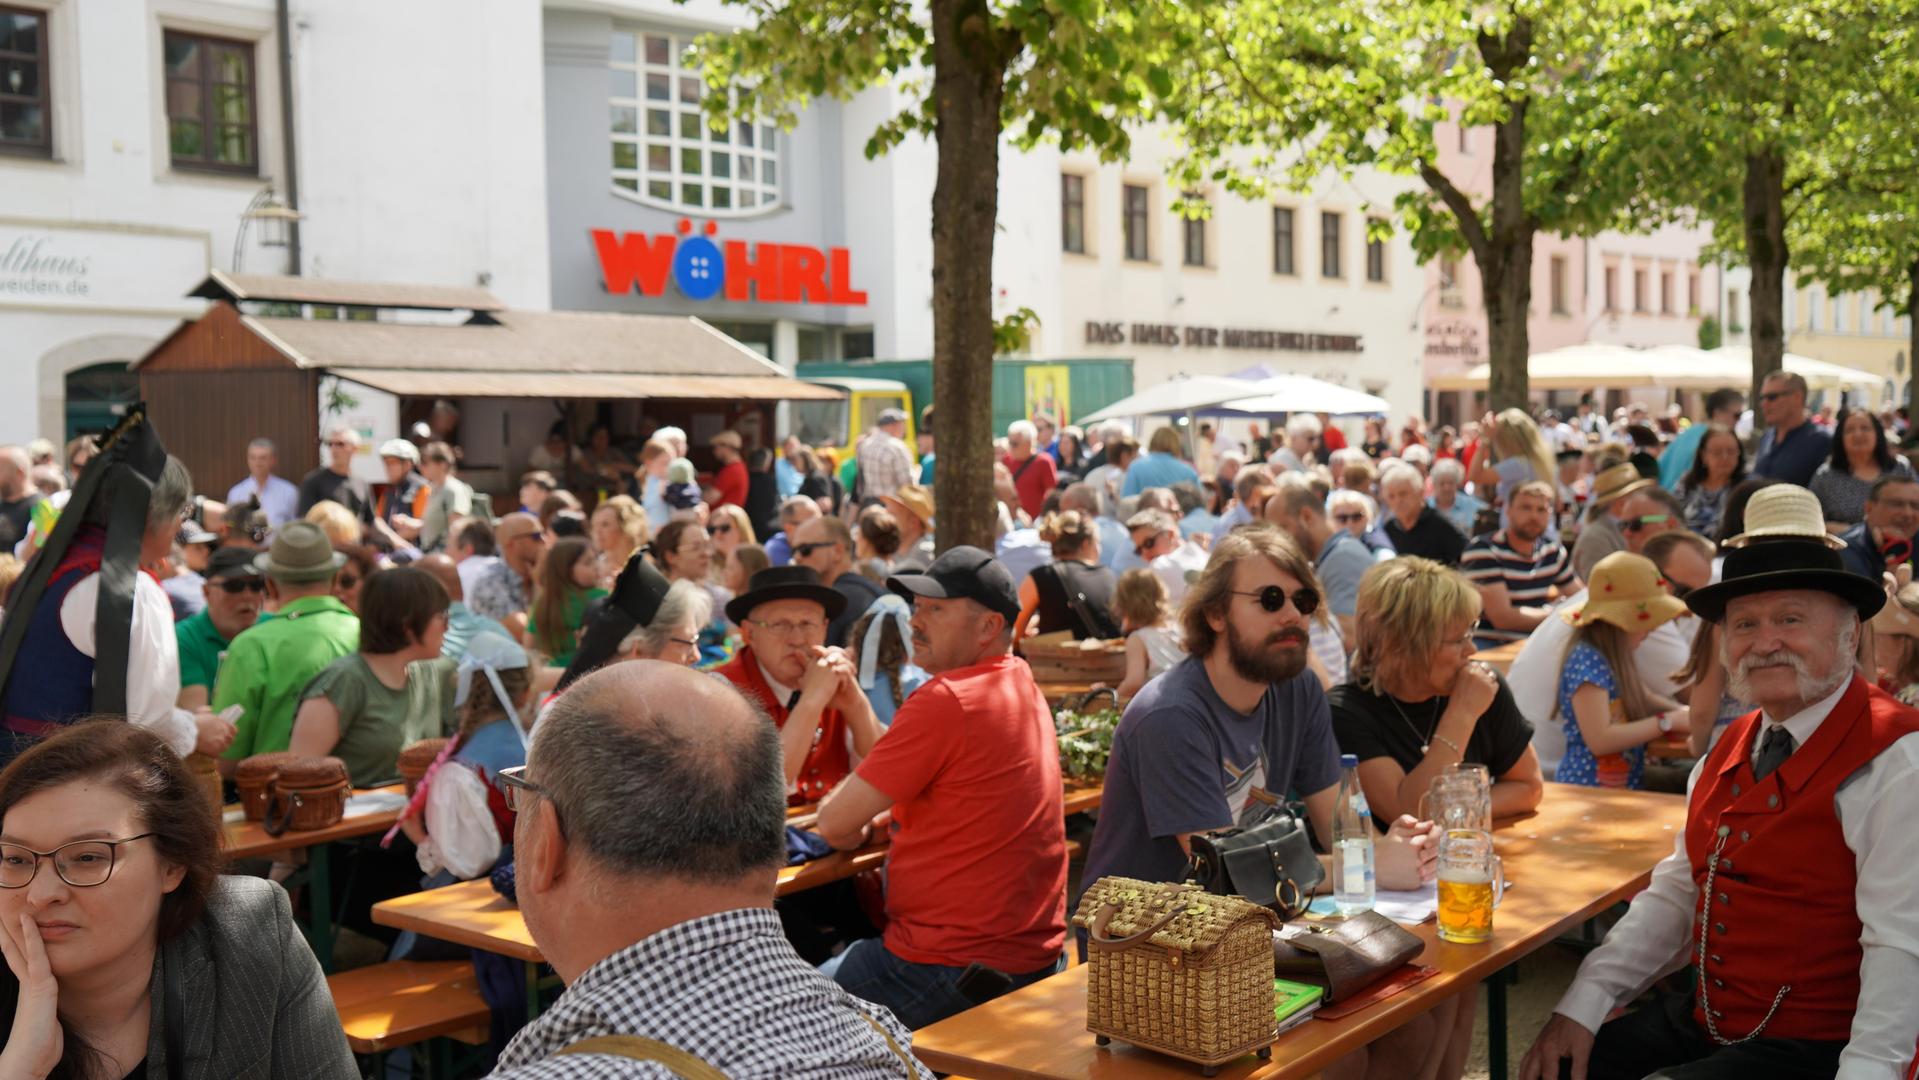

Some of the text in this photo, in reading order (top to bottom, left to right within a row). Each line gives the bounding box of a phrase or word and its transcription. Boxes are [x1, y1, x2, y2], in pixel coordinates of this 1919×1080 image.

[591, 217, 867, 305] WÖHRL
[1085, 321, 1125, 344] DAS
[1131, 323, 1179, 347] HAUS
[1184, 326, 1218, 348] DER
